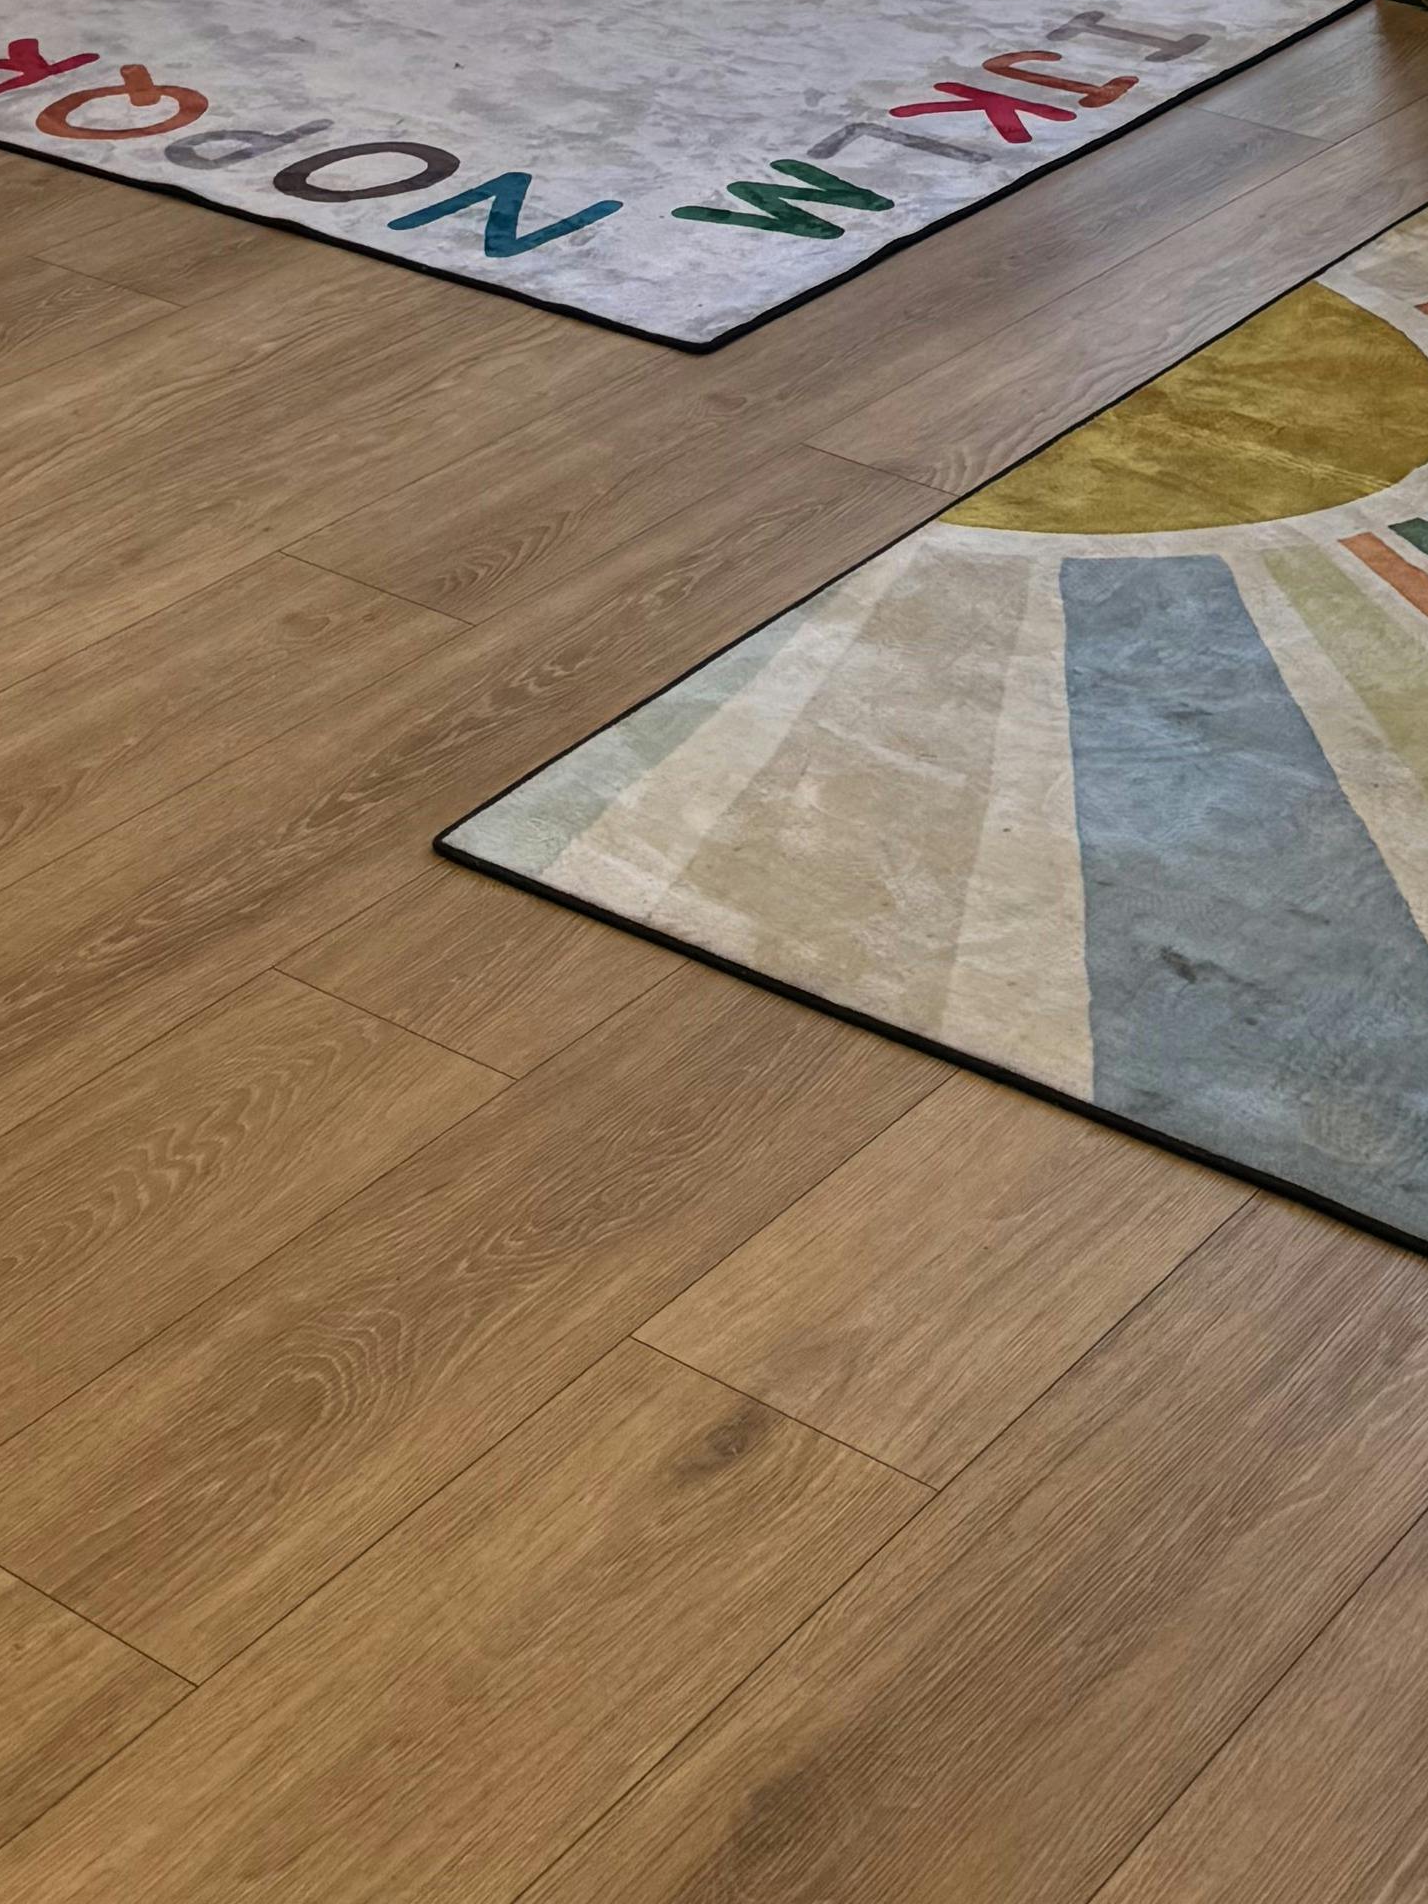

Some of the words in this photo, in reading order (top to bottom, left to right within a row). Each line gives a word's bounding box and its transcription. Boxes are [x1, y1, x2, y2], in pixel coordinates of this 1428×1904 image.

[34, 62, 210, 140] Q
[888, 81, 1078, 145] K
[271, 140, 461, 203] O
[386, 171, 625, 259] N
